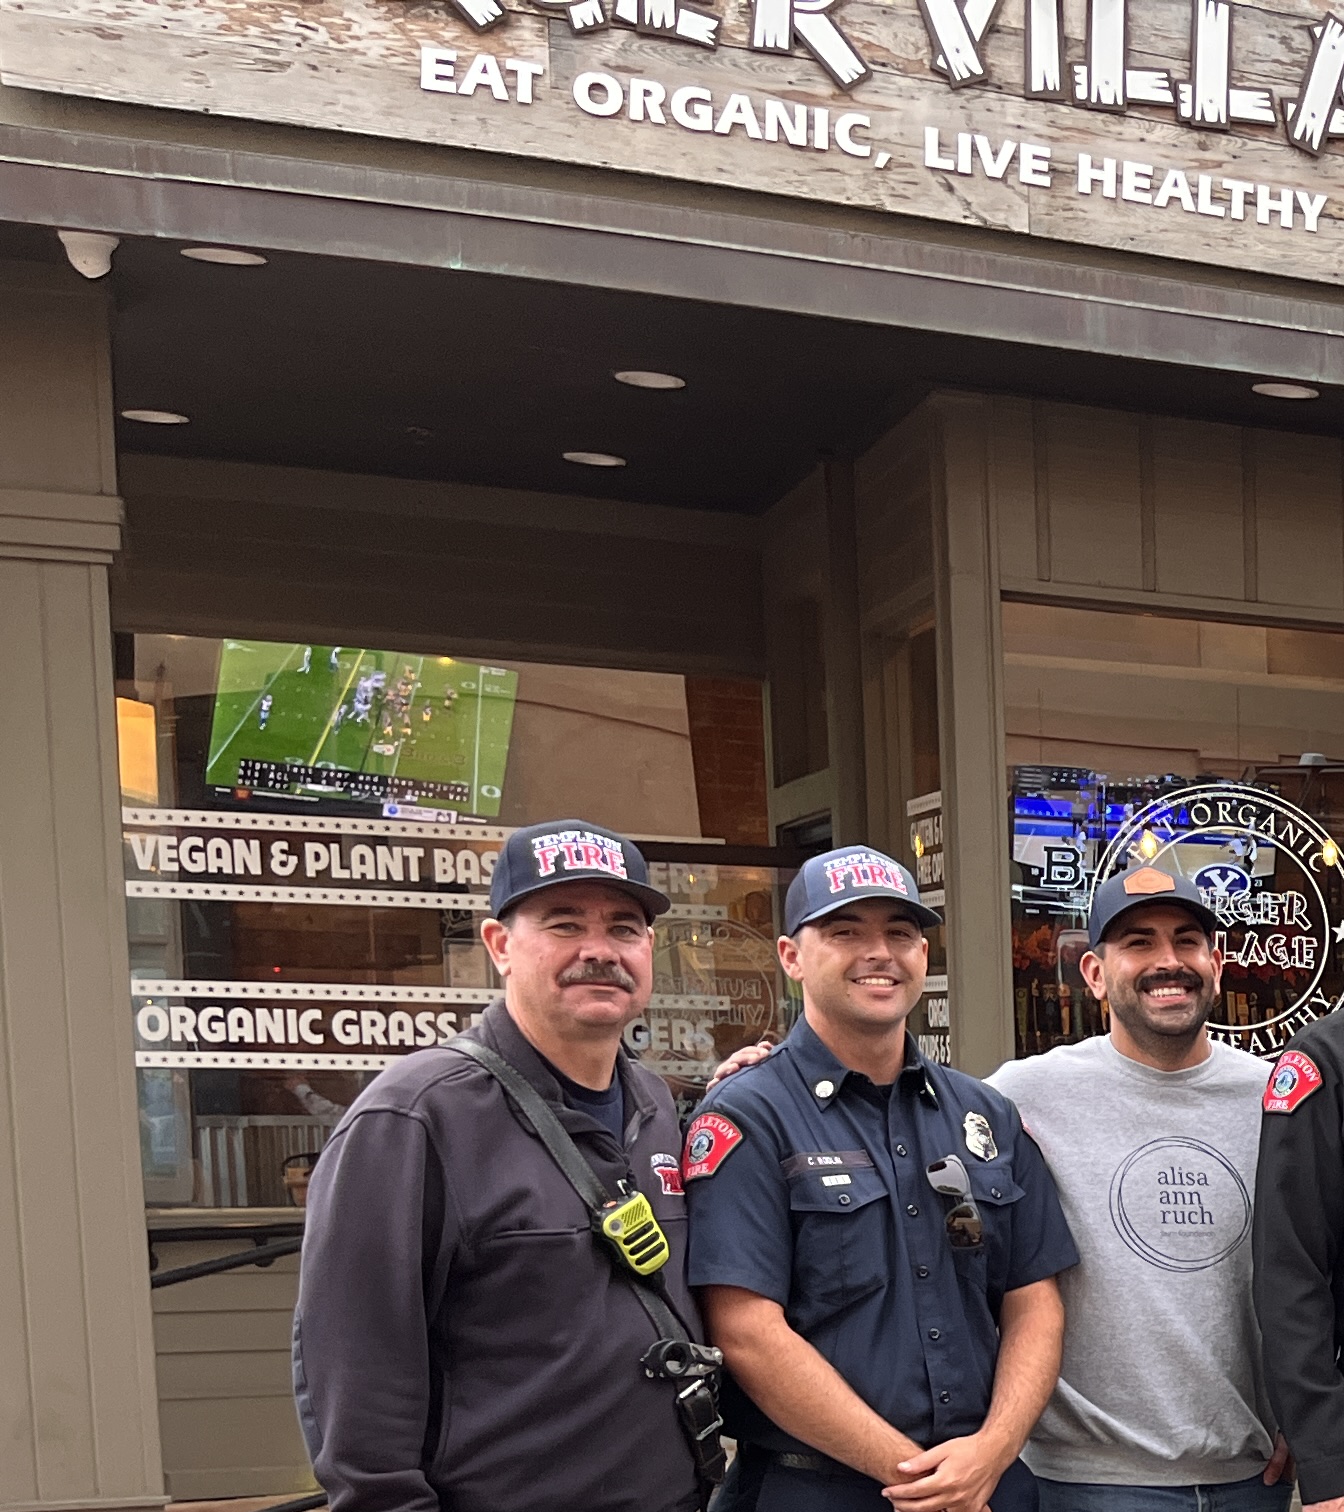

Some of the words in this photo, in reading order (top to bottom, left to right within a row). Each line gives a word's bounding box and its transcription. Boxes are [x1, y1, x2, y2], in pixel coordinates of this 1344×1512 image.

[420, 46, 543, 104] EAT
[572, 71, 891, 168] ORGANIC,
[923, 126, 1052, 188] LIVE
[1077, 153, 1327, 233] HEALTHY
[531, 830, 622, 853] TEMPLETON
[1126, 814, 1177, 864] ET
[1191, 802, 1325, 873] ORGANIC
[130, 834, 262, 876] VEGAN
[270, 840, 299, 878] &
[304, 842, 425, 883] PLANT
[433, 849, 498, 886] BAS
[534, 842, 628, 879] FIRE
[823, 852, 901, 872] TEMPLETON
[825, 863, 908, 895] FIRE
[1202, 890, 1312, 931] RGER
[1215, 931, 1318, 970] LAGE
[136, 1005, 325, 1046] ORGANIC
[331, 1009, 457, 1047] GRASS
[623, 1017, 715, 1051] GERS
[1157, 1166, 1209, 1186] alisa
[1159, 1190, 1204, 1205] ann
[1160, 1205, 1214, 1225] ruch
